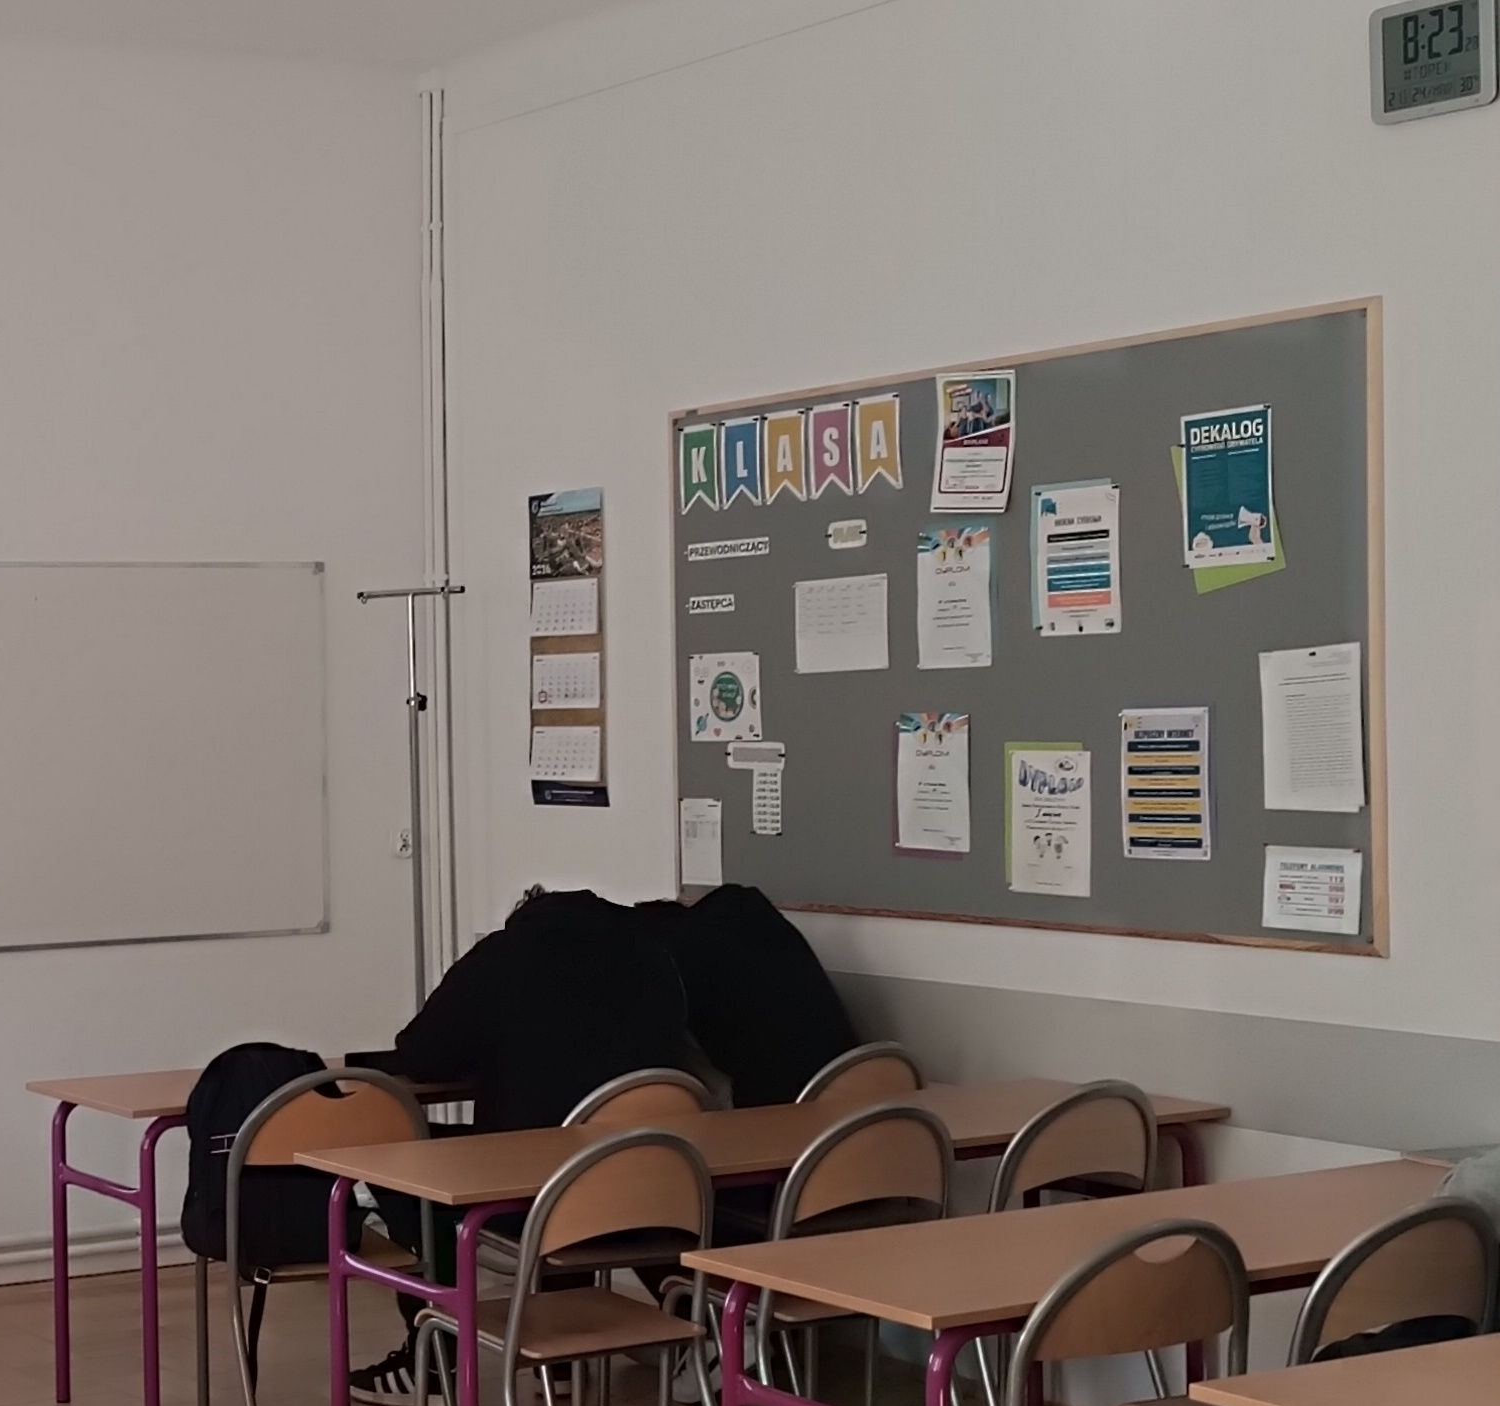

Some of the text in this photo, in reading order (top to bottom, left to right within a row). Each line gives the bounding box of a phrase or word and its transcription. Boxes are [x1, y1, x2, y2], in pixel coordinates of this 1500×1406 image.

[1403, 4, 1463, 65] 8:23
[1190, 418, 1264, 445] DEKALOG
[691, 420, 888, 484] KLASA
[689, 541, 768, 558] PRZEWODNICZĄCY
[691, 597, 732, 611] ZASTĘPCA
